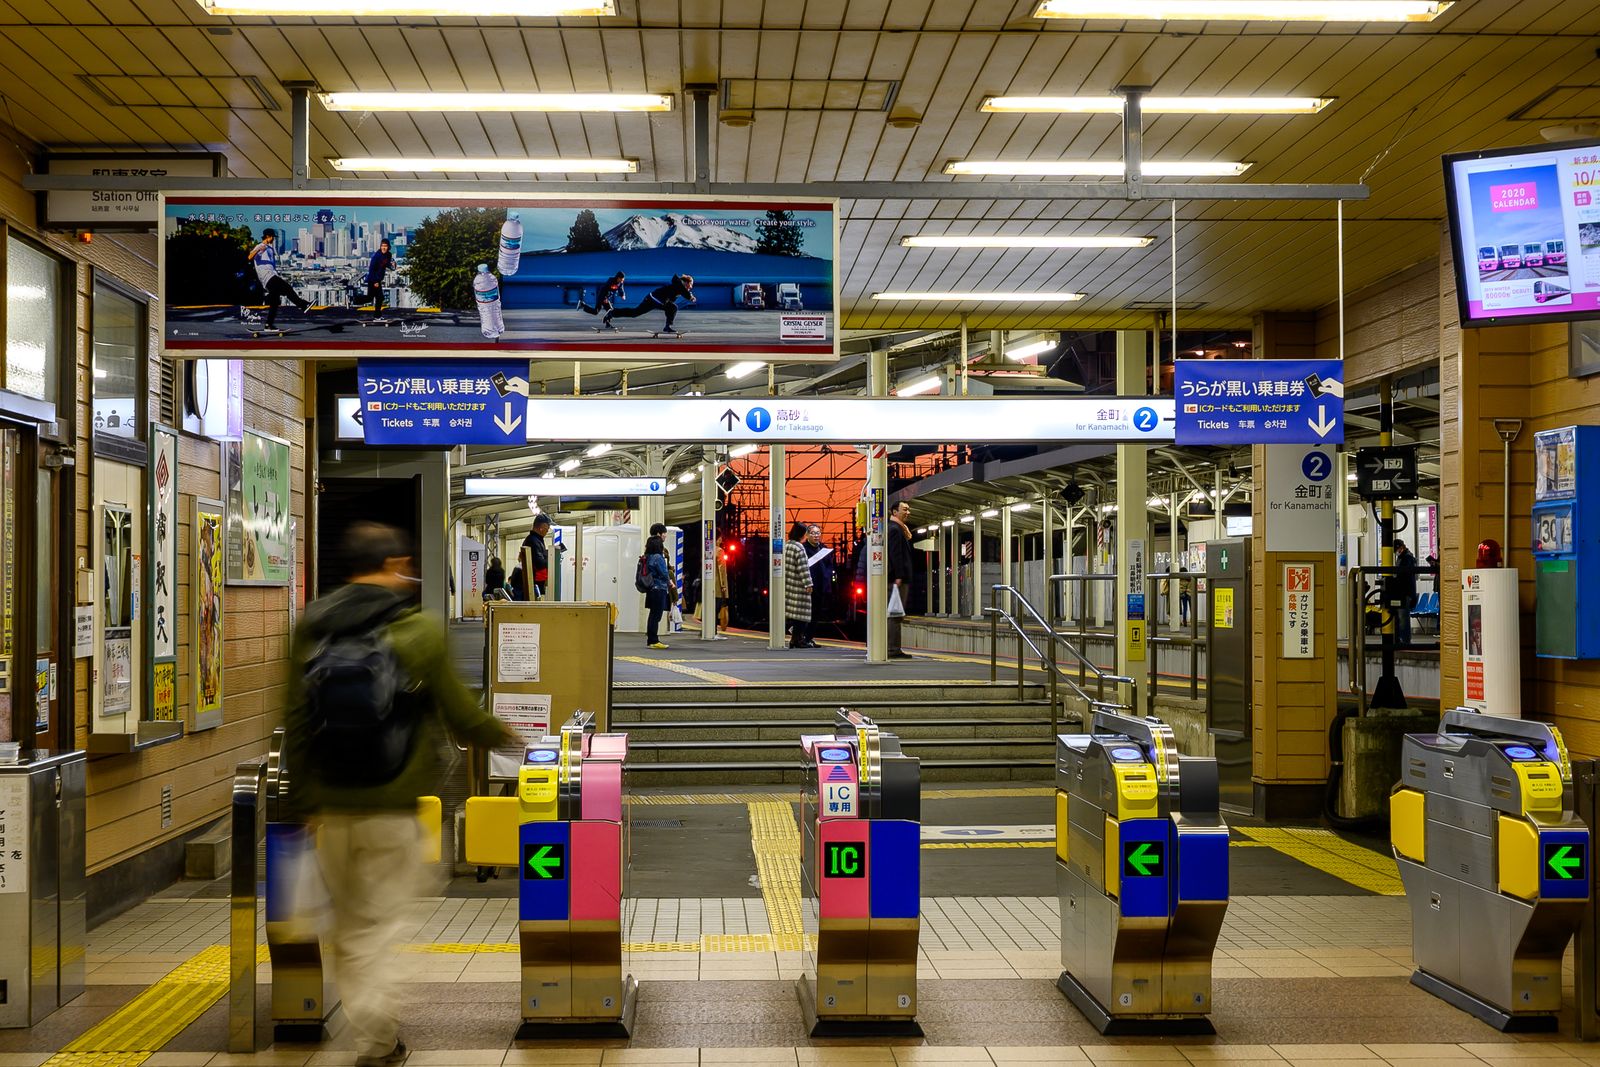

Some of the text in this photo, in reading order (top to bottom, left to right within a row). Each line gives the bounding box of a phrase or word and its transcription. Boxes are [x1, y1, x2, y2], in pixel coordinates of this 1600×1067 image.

[1574, 170, 1600, 186] 10/
[92, 190, 132, 202] Station
[1502, 187, 1526, 199] 2020
[1493, 197, 1536, 209] CALENDAR
[682, 218, 709, 227] Choose
[710, 219, 728, 227] your
[754, 218, 778, 228] Create
[779, 219, 795, 228] your
[796, 219, 816, 228] style.
[363, 378, 491, 395] うらが黒い乗車券
[1180, 380, 1305, 397] うらが黒い乗車券
[383, 402, 487, 411] ICカードもご利用いただけます
[1199, 404, 1300, 413] ICカードもご利用いただけます
[381, 417, 413, 428] Tickets
[1076, 423, 1129, 431] for Kanamachi
[1197, 419, 1229, 430] Tickets
[789, 424, 824, 432] Takasago
[1270, 500, 1332, 510] for Kanamachi
[1288, 593, 1297, 629] 危険です
[1300, 594, 1309, 655] かけこみ乗車は
[829, 786, 851, 801] IC
[829, 802, 851, 813] 専用
[831, 847, 859, 875] IC
[828, 996, 834, 1005] 2
[901, 996, 907, 1005] 3
[1123, 995, 1129, 1005] 3
[1195, 995, 1201, 1004] 4
[1523, 991, 1529, 1000] 4
[306, 1000, 311, 1008] 1
[532, 998, 537, 1007] 1
[605, 998, 611, 1007] 2
